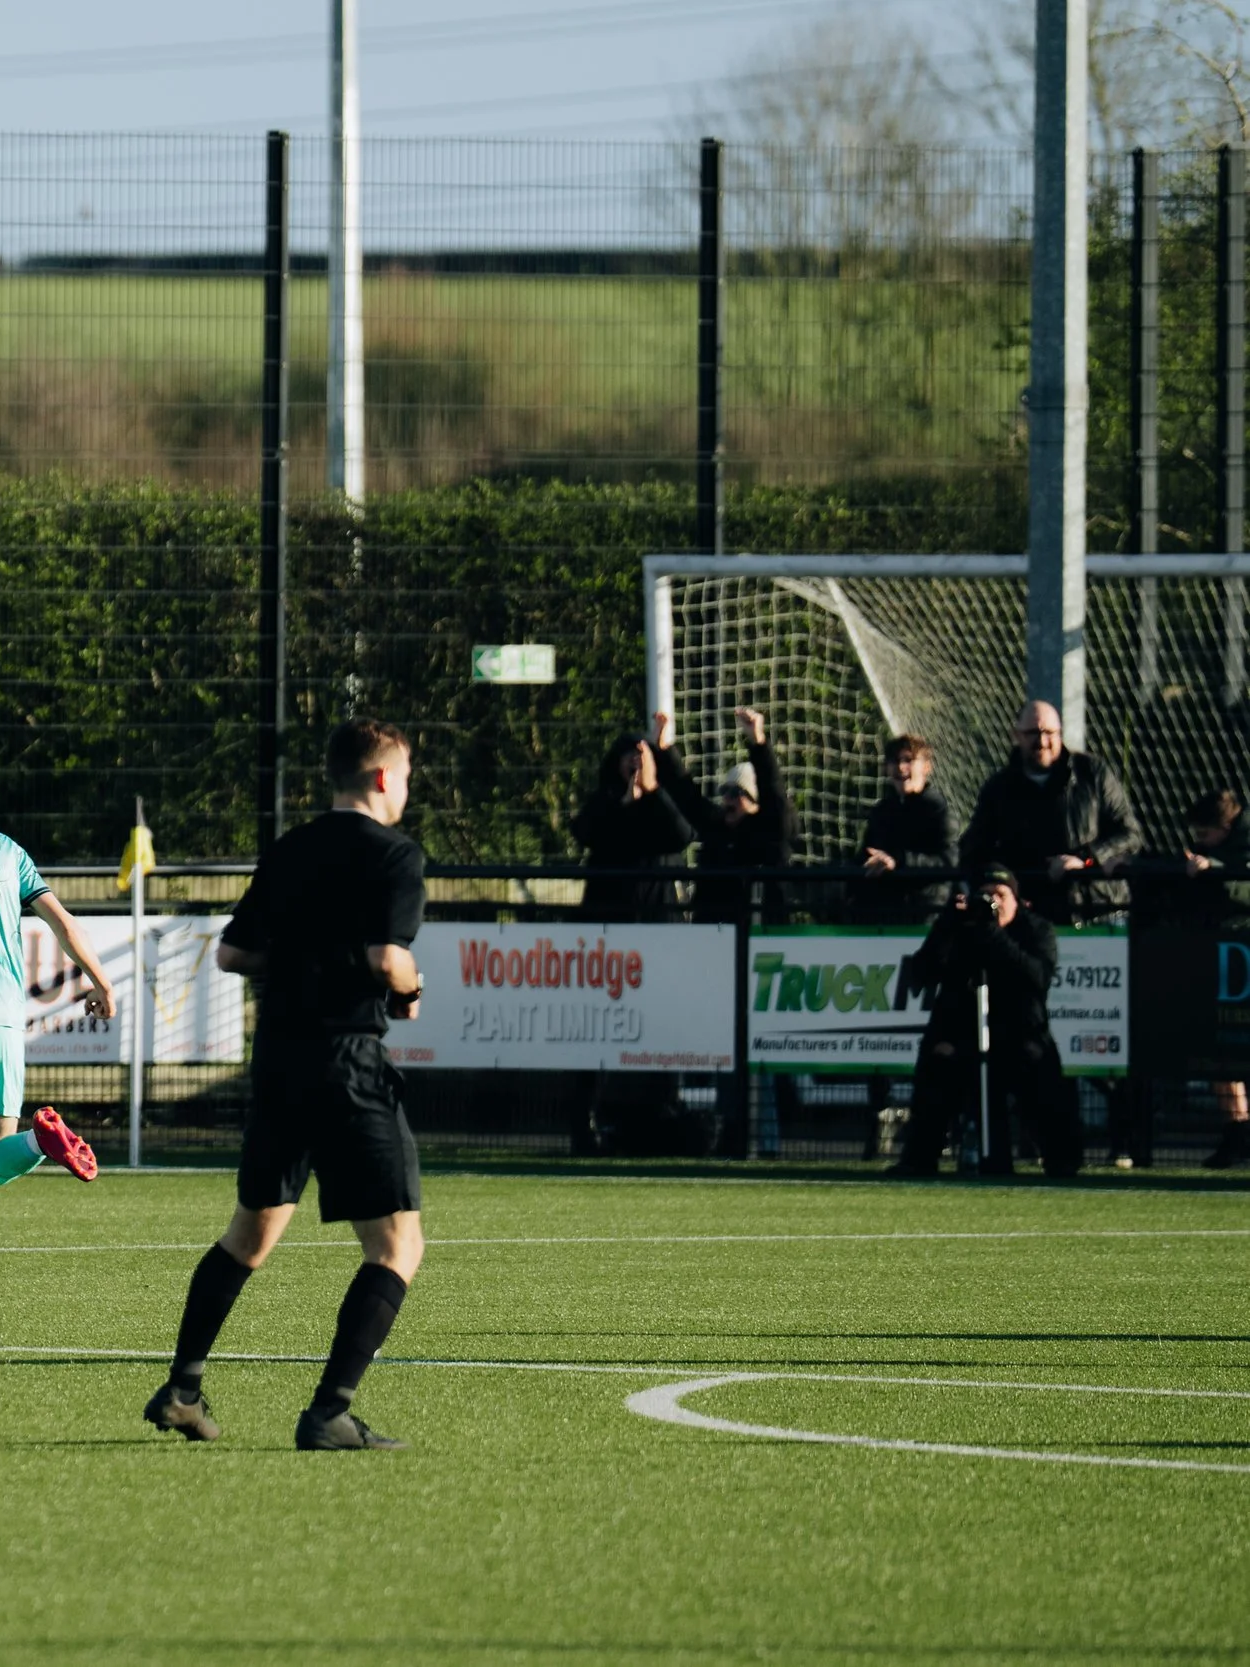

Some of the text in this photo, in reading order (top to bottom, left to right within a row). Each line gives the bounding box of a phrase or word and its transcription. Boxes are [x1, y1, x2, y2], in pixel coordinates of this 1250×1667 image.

[458, 937, 642, 1000] Woodbridge
[753, 952, 937, 1012] TRUCKM
[1065, 965, 1121, 988] 479122
[459, 1003, 643, 1042] PLANT LIMITED
[1047, 1005, 1121, 1020] uckmax.co.uk
[753, 1035, 837, 1051] Manufacturers
[841, 1035, 855, 1051] of
[857, 1036, 912, 1051] Stainless
